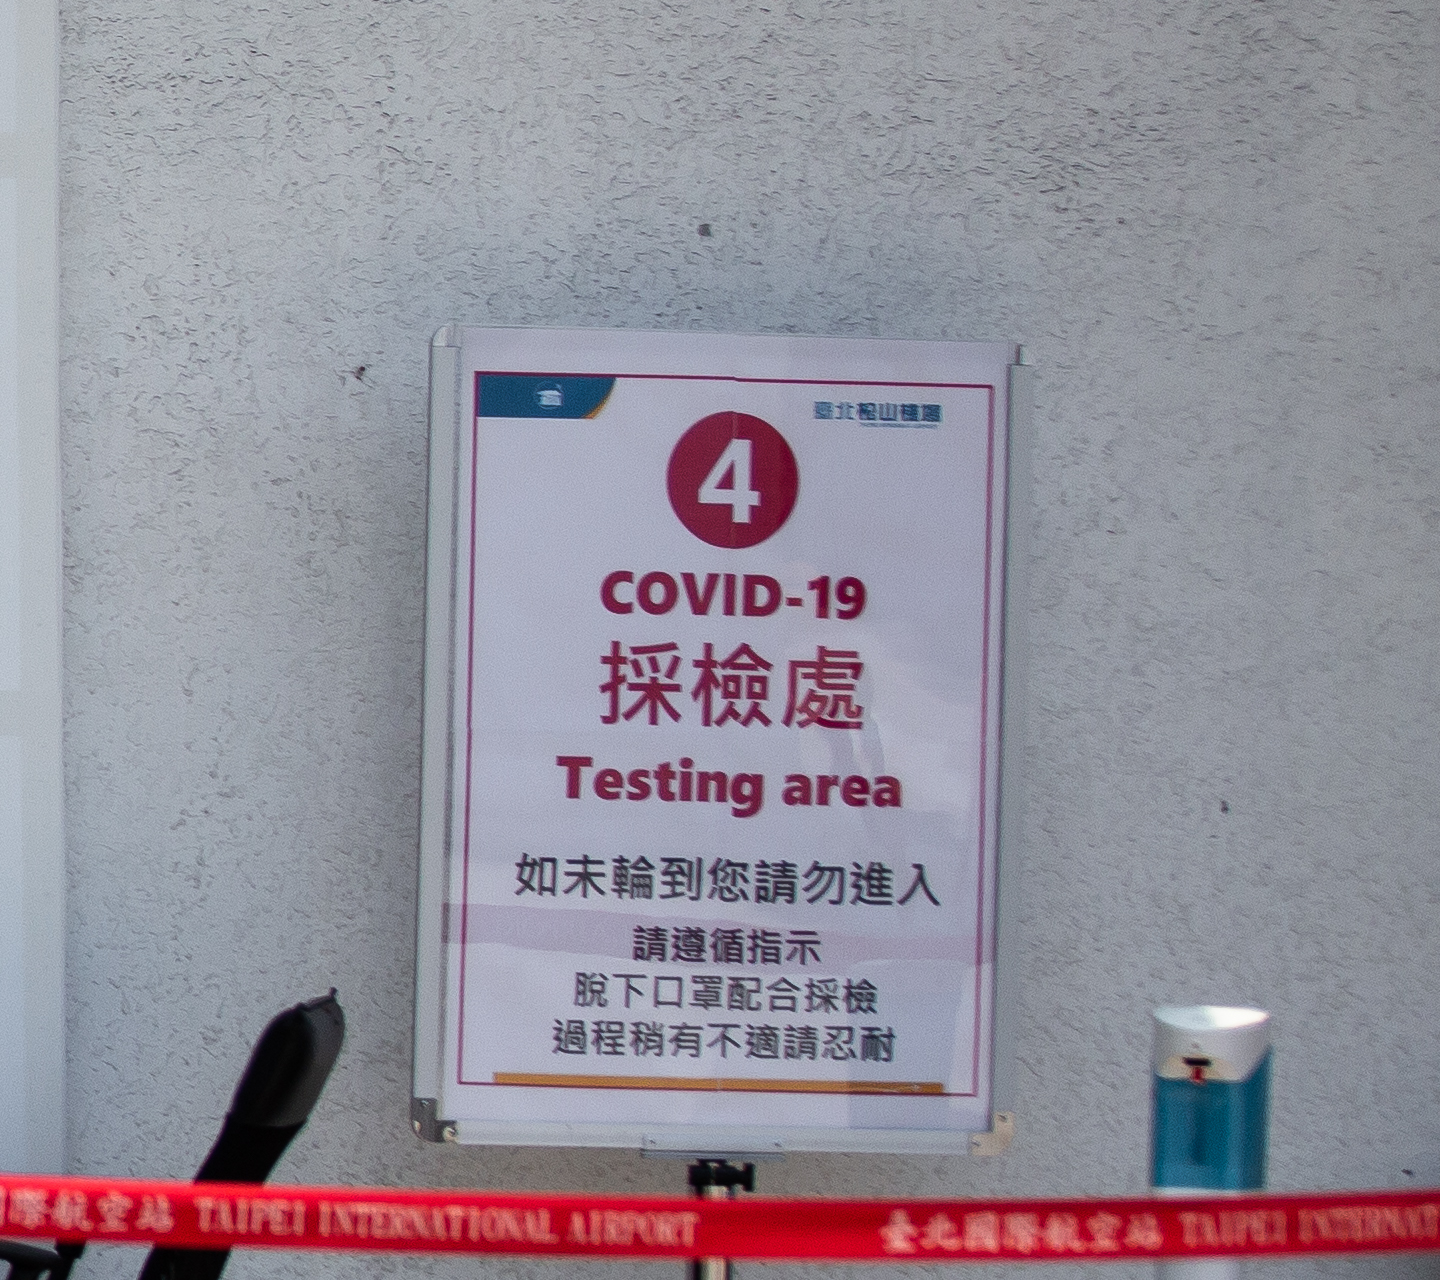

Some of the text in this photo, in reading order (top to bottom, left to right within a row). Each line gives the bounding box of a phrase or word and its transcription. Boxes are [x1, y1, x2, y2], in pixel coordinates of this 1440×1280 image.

[698, 438, 762, 524] 4
[601, 571, 866, 620] COVID-19
[600, 641, 863, 729] 採檢處
[557, 756, 901, 818] Testing area
[516, 853, 940, 906] 如未輪到您請勿進入
[633, 926, 821, 965] 請遵循指示
[553, 1020, 897, 1063] 過程稍有不適請忍耐
[194, 1196, 306, 1236] TAIPEI
[318, 1200, 560, 1245] INTERNATIONAL
[569, 1209, 700, 1248] AIRPORT
